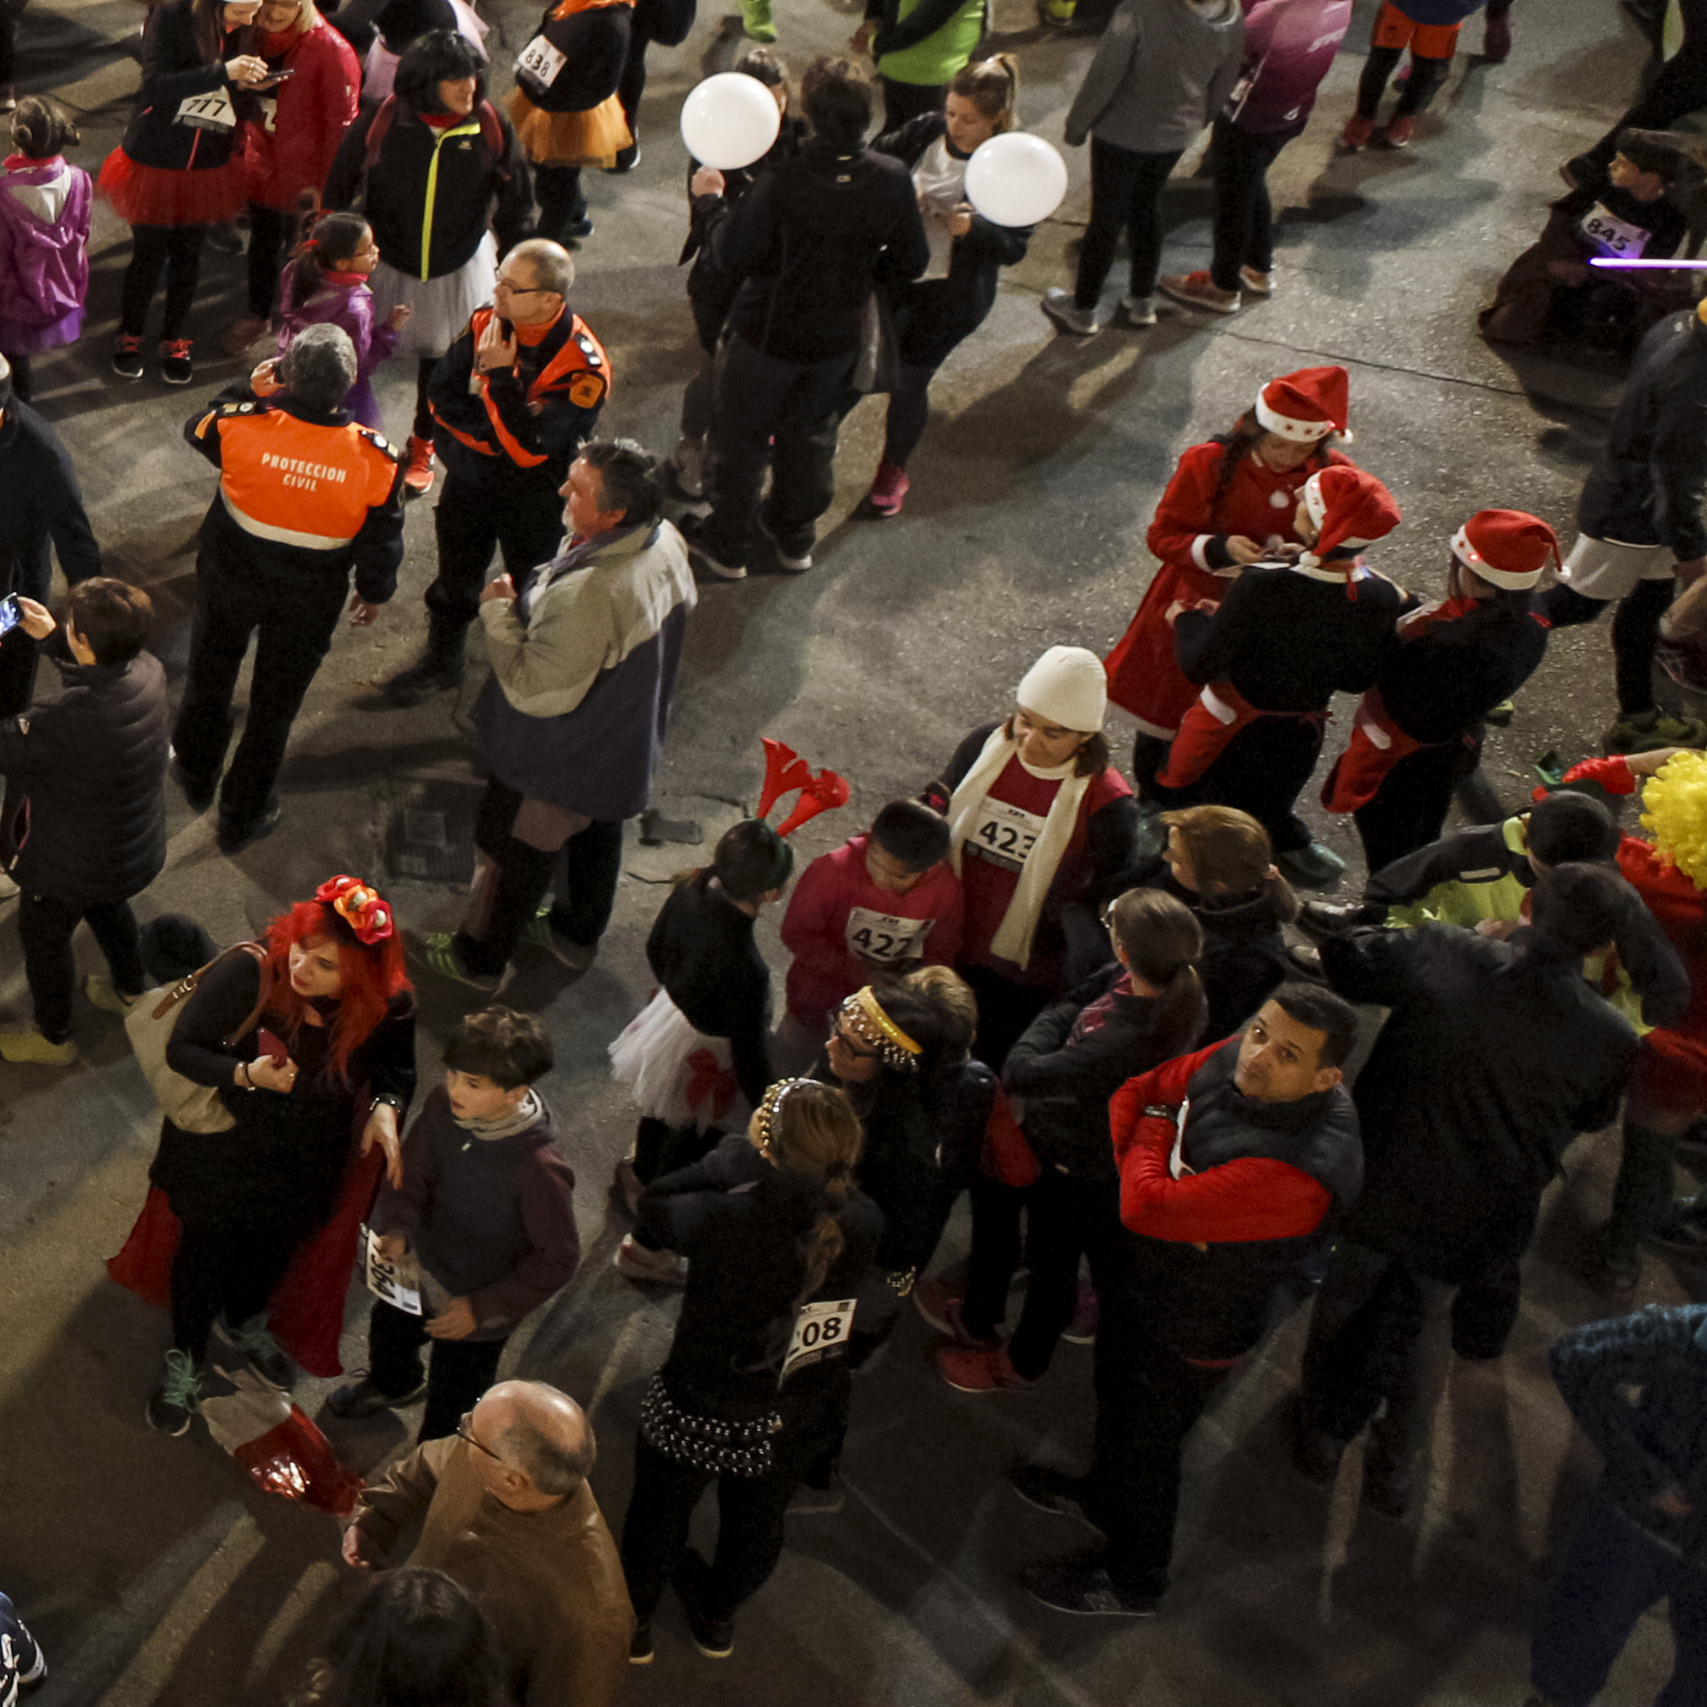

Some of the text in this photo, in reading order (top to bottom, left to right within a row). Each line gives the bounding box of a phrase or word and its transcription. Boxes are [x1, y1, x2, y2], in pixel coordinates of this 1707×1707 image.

[524, 47, 551, 74] 838
[189, 99, 227, 117] 777
[1587, 218, 1627, 250] 845
[261, 452, 346, 483] PROTECCION
[283, 470, 317, 492] CIVIL
